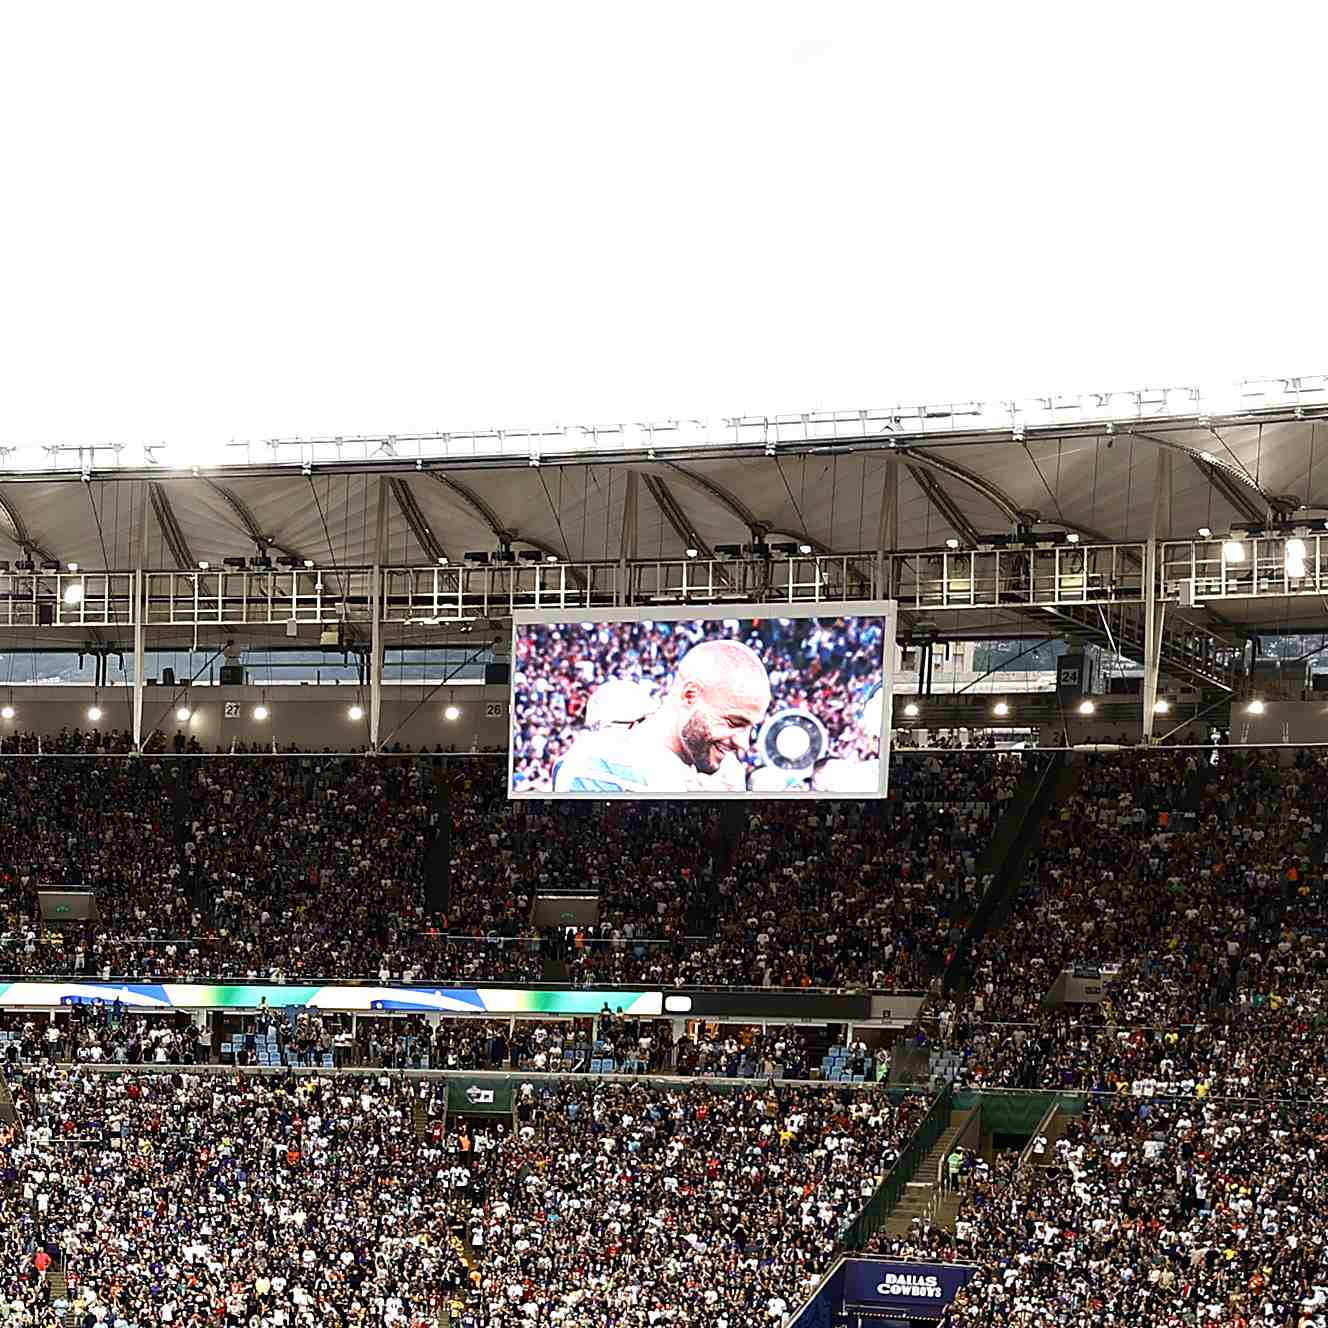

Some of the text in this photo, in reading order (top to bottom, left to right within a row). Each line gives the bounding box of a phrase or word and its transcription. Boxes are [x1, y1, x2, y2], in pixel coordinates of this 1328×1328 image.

[226, 704, 239, 716] 27
[487, 704, 501, 715] 26
[885, 1273, 938, 1287] DALLAS
[876, 1283, 942, 1298] COWBOYS
